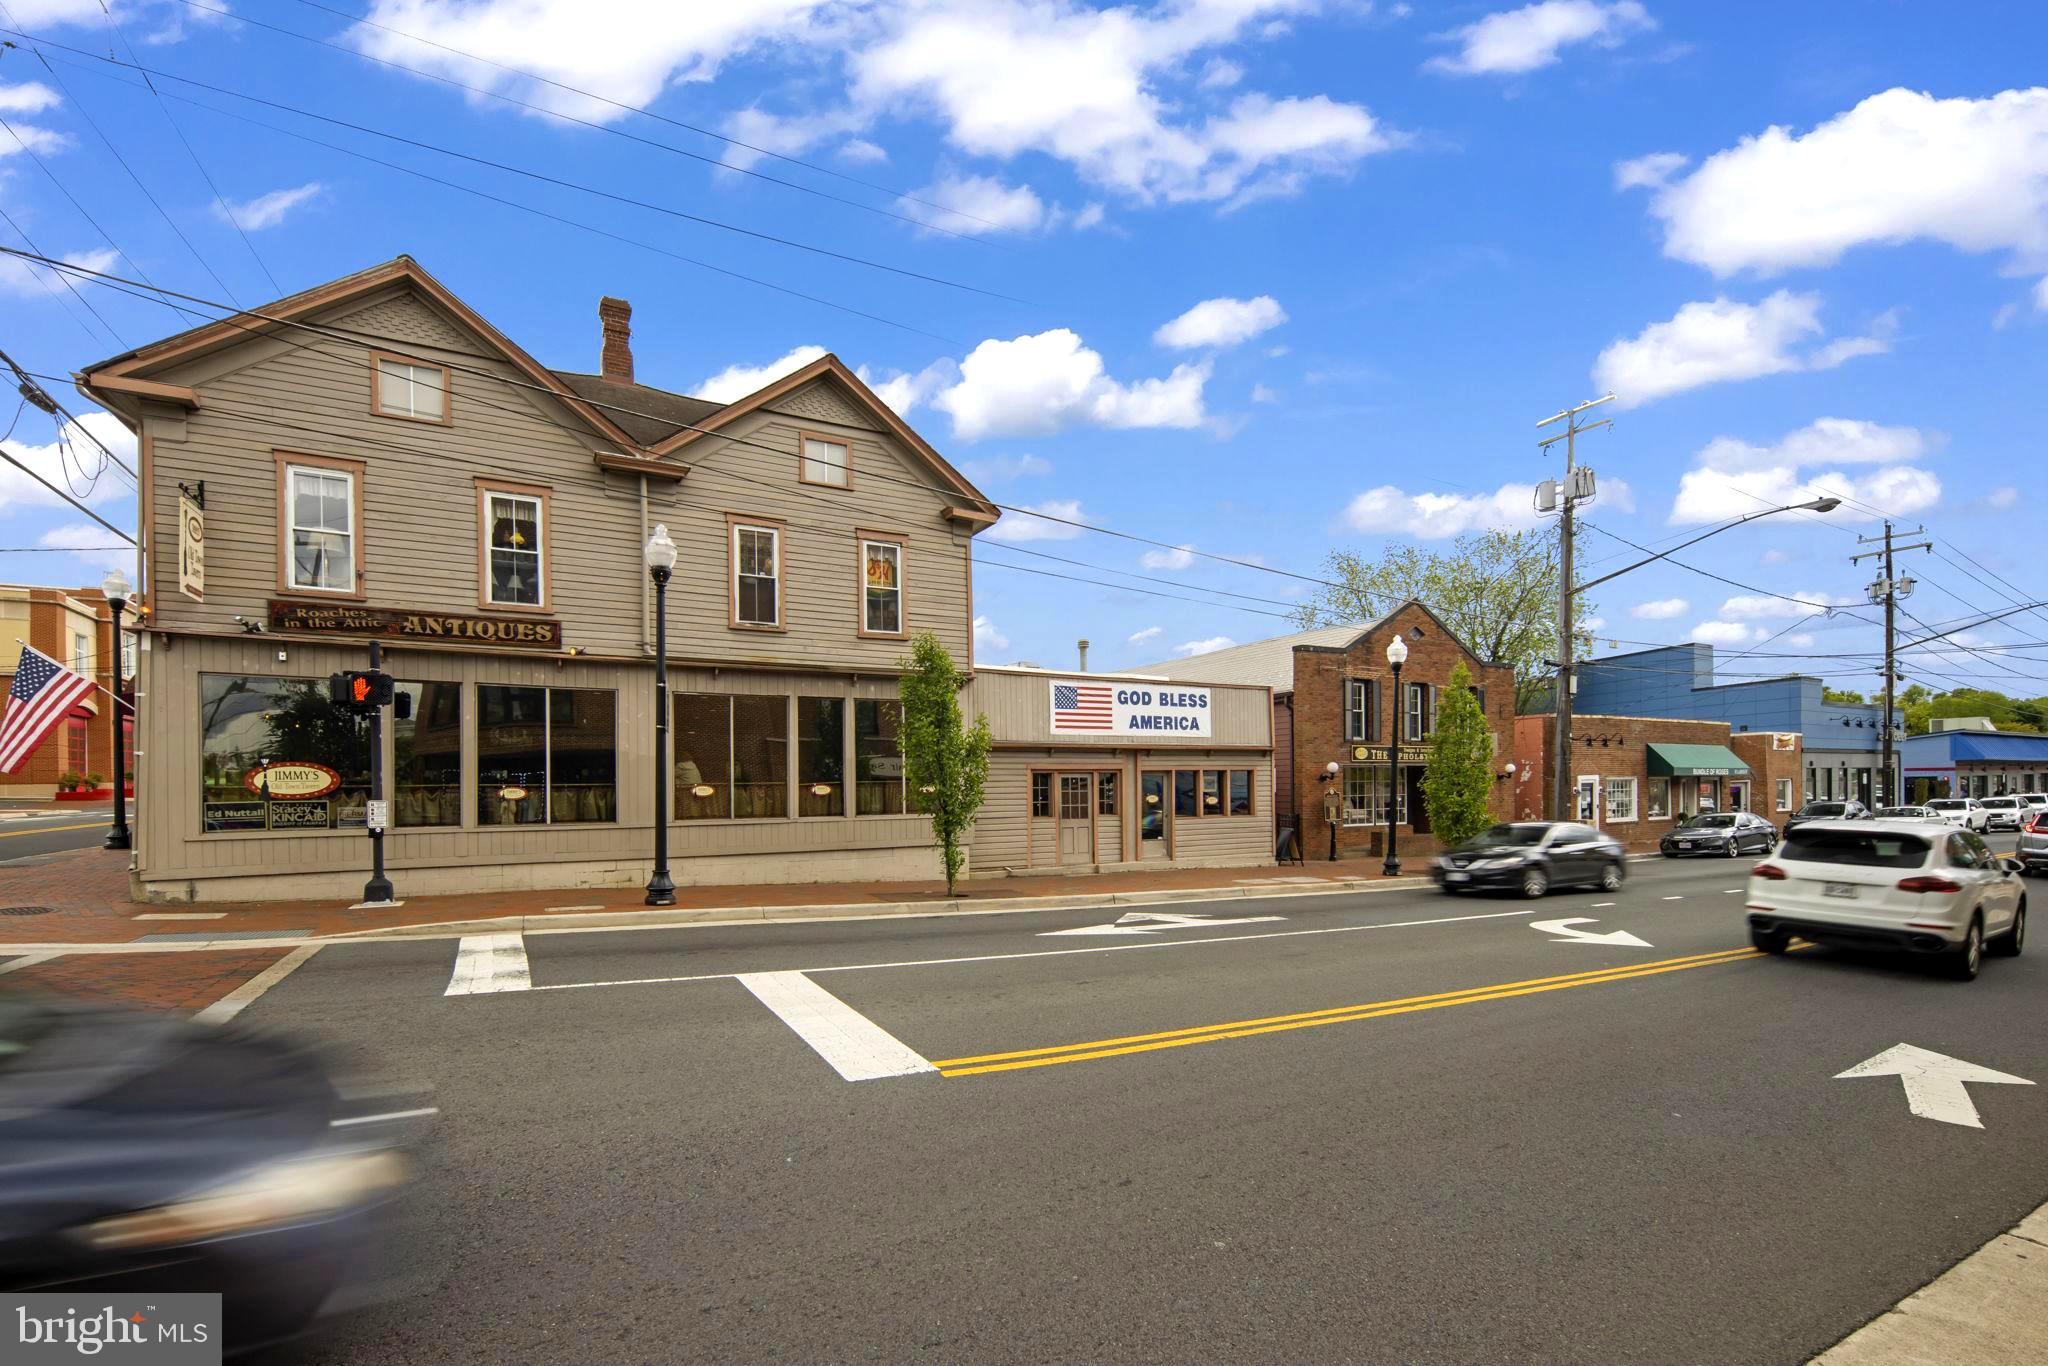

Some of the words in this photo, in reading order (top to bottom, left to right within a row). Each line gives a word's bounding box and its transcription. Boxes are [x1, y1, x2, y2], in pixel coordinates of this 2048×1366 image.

[296, 607, 367, 618] Roaches
[284, 618, 300, 628] in
[308, 618, 336, 628] the
[344, 617, 382, 628] Attic
[403, 615, 553, 642] ANTIQUES
[1117, 690, 1152, 706] GOD
[1159, 692, 1208, 708] BLESS
[1129, 715, 1200, 731] AMERICA
[1371, 749, 1388, 760] THE
[274, 770, 319, 782] JIMMY'S
[207, 810, 222, 818] Ed
[225, 809, 265, 817] Nuttall
[272, 804, 311, 816] Stacey
[272, 812, 327, 822] KINCAID
